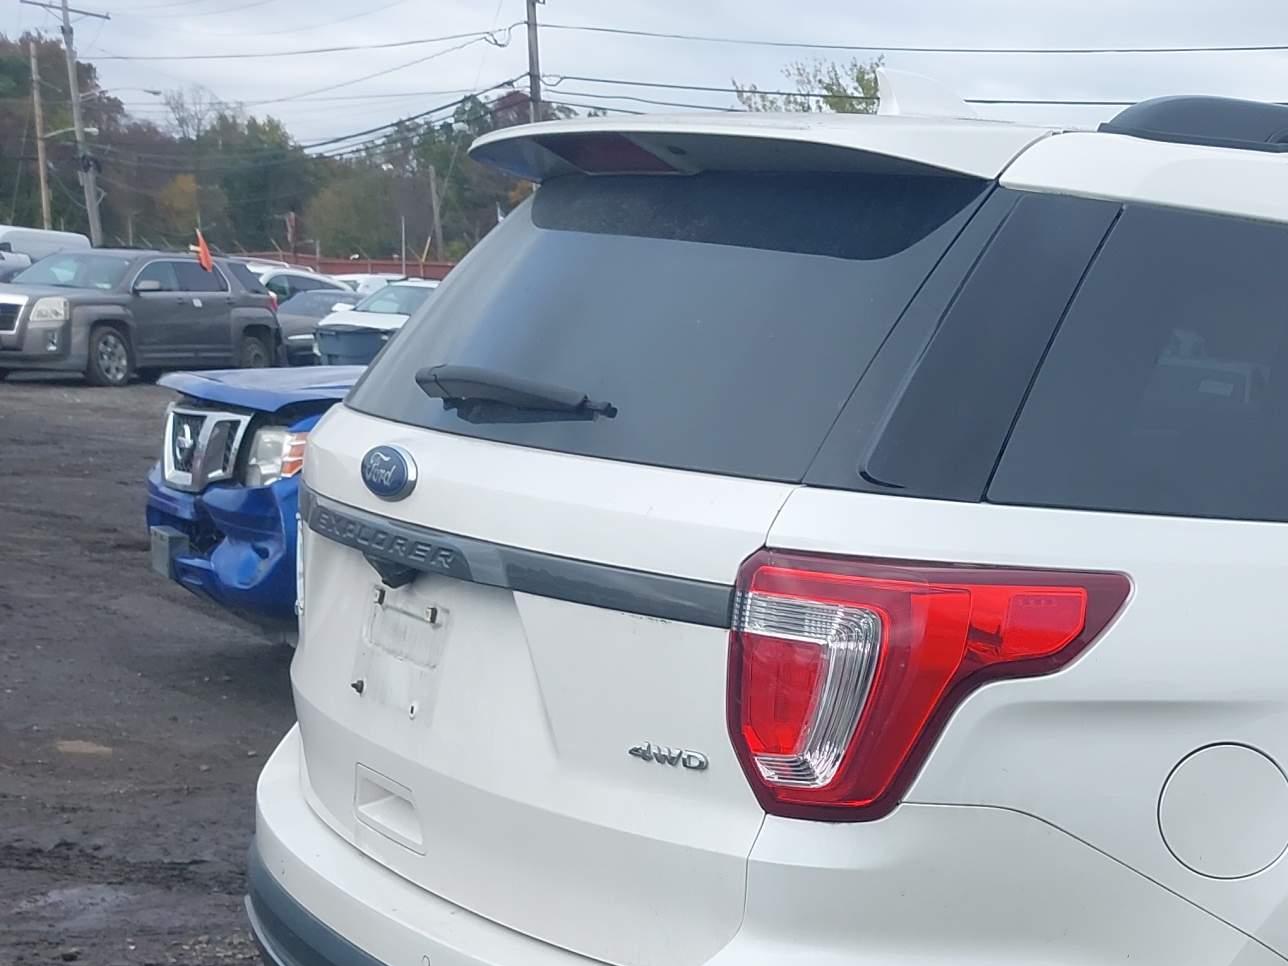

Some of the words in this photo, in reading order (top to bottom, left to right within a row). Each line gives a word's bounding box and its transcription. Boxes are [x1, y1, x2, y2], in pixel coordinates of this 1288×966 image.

[364, 451, 397, 487] Ford
[318, 511, 455, 569] EXPLORER
[628, 741, 709, 770] 4WD
